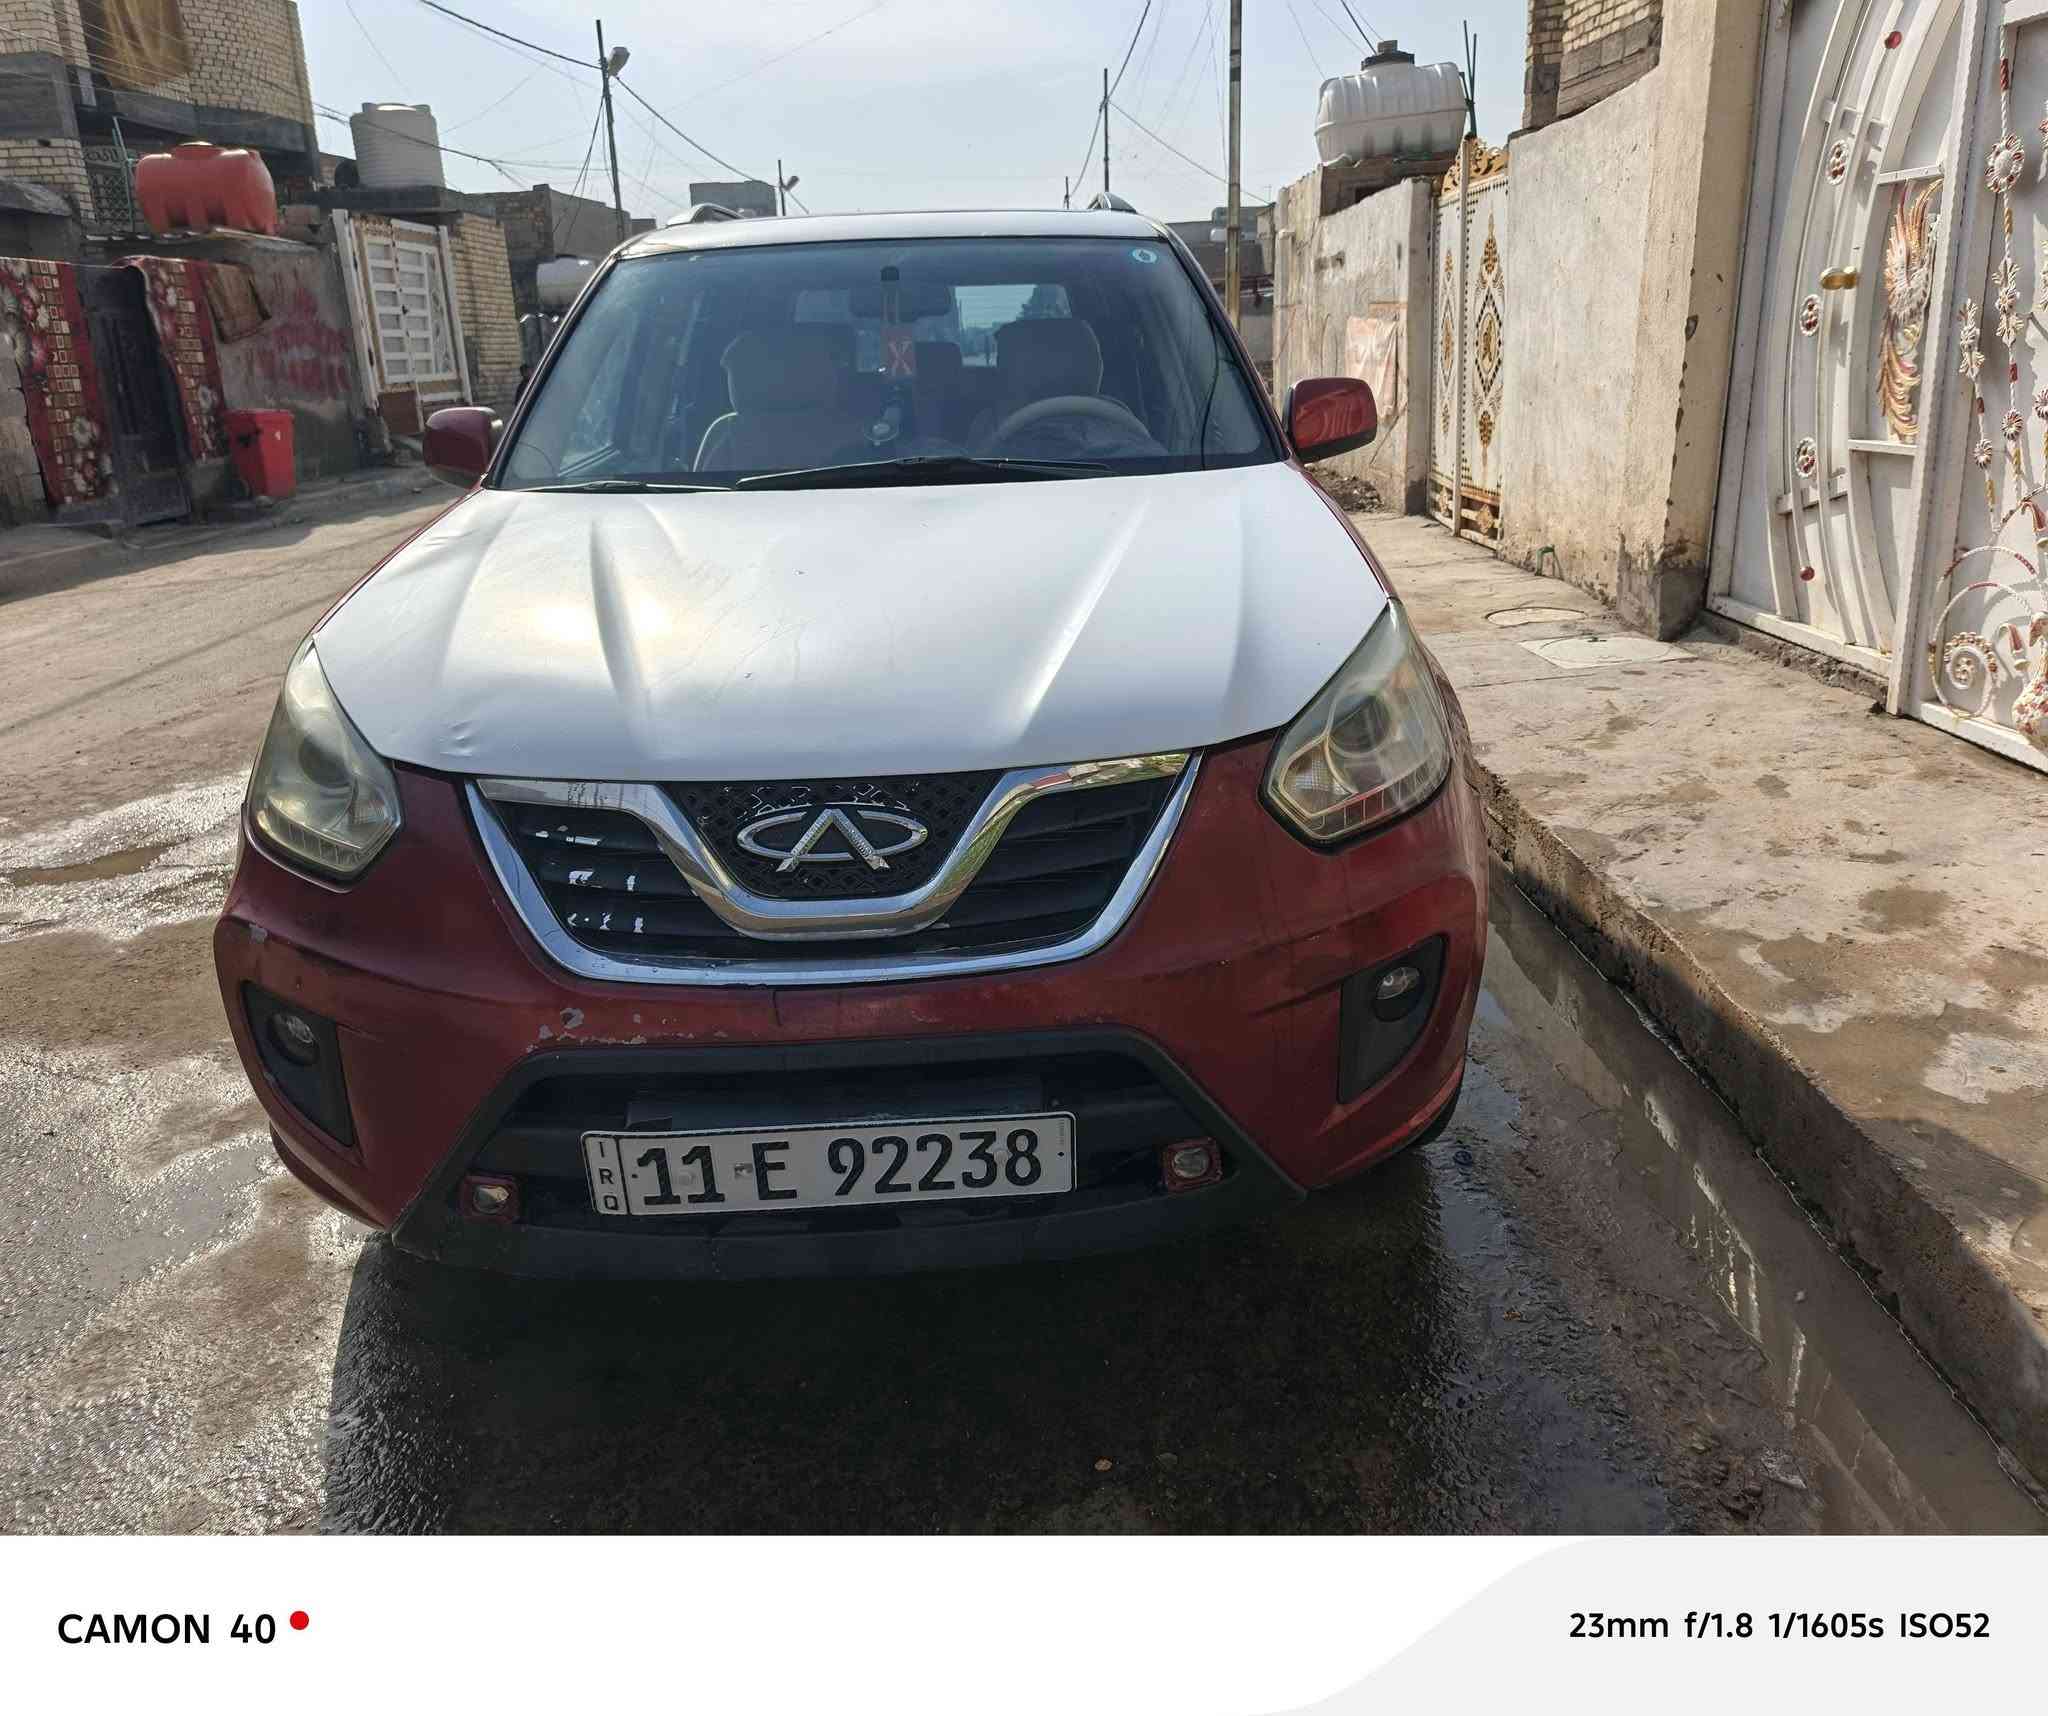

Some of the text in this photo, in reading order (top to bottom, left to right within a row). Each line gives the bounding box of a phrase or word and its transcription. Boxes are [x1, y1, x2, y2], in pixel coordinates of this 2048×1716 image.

[597, 1141, 619, 1211] IRQ
[636, 1145, 726, 1206] 11
[752, 1141, 798, 1201] E
[828, 1128, 1042, 1197] 92238
